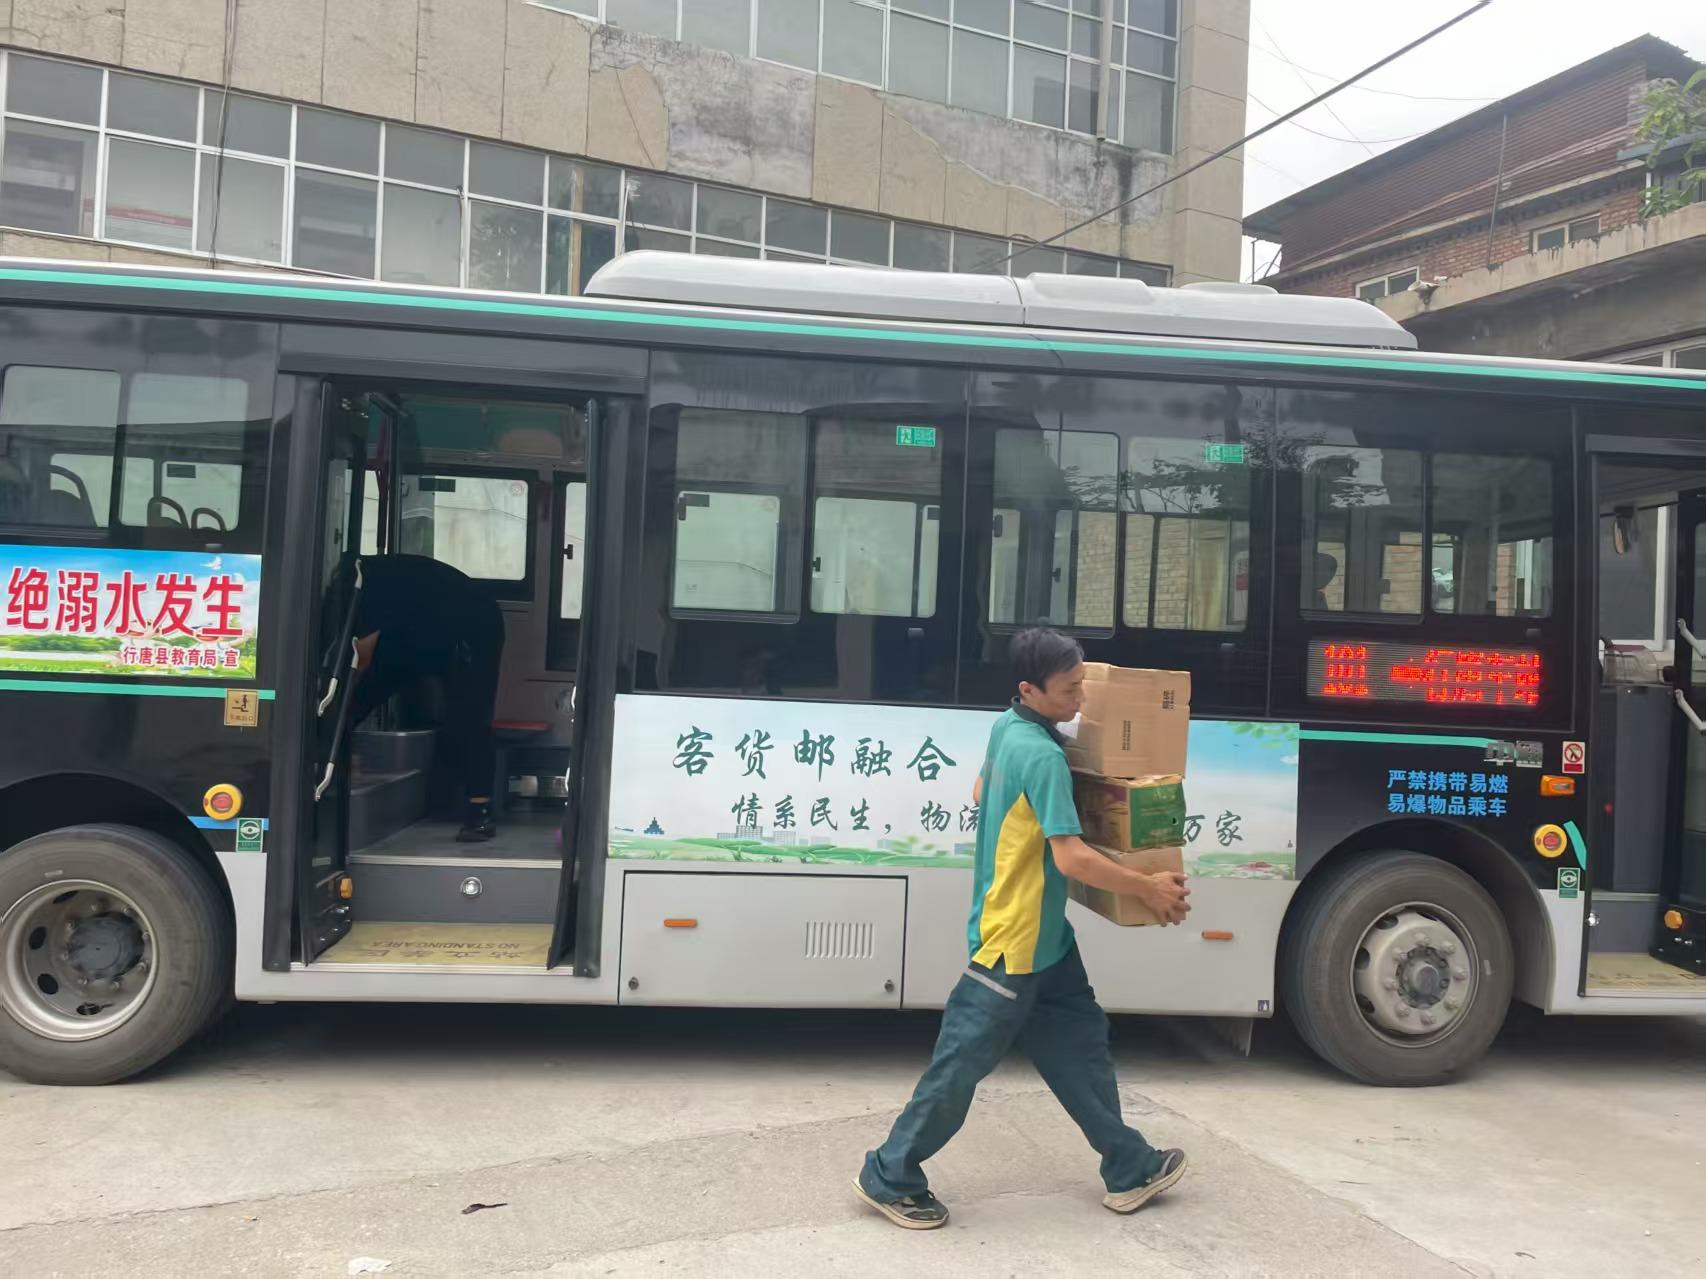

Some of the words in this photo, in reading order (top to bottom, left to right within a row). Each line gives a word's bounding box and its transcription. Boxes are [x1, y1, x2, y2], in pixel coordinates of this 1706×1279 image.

[6, 567, 244, 637] 绝溺水发生
[122, 647, 217, 667] 行唐县教育局
[223, 650, 240, 668] 宣
[673, 726, 957, 782] 客货邮融合
[1387, 769, 1508, 794] 严禁携带易燃
[1387, 793, 1507, 817] 易爆物品乘车
[1183, 810, 1243, 847] 万家
